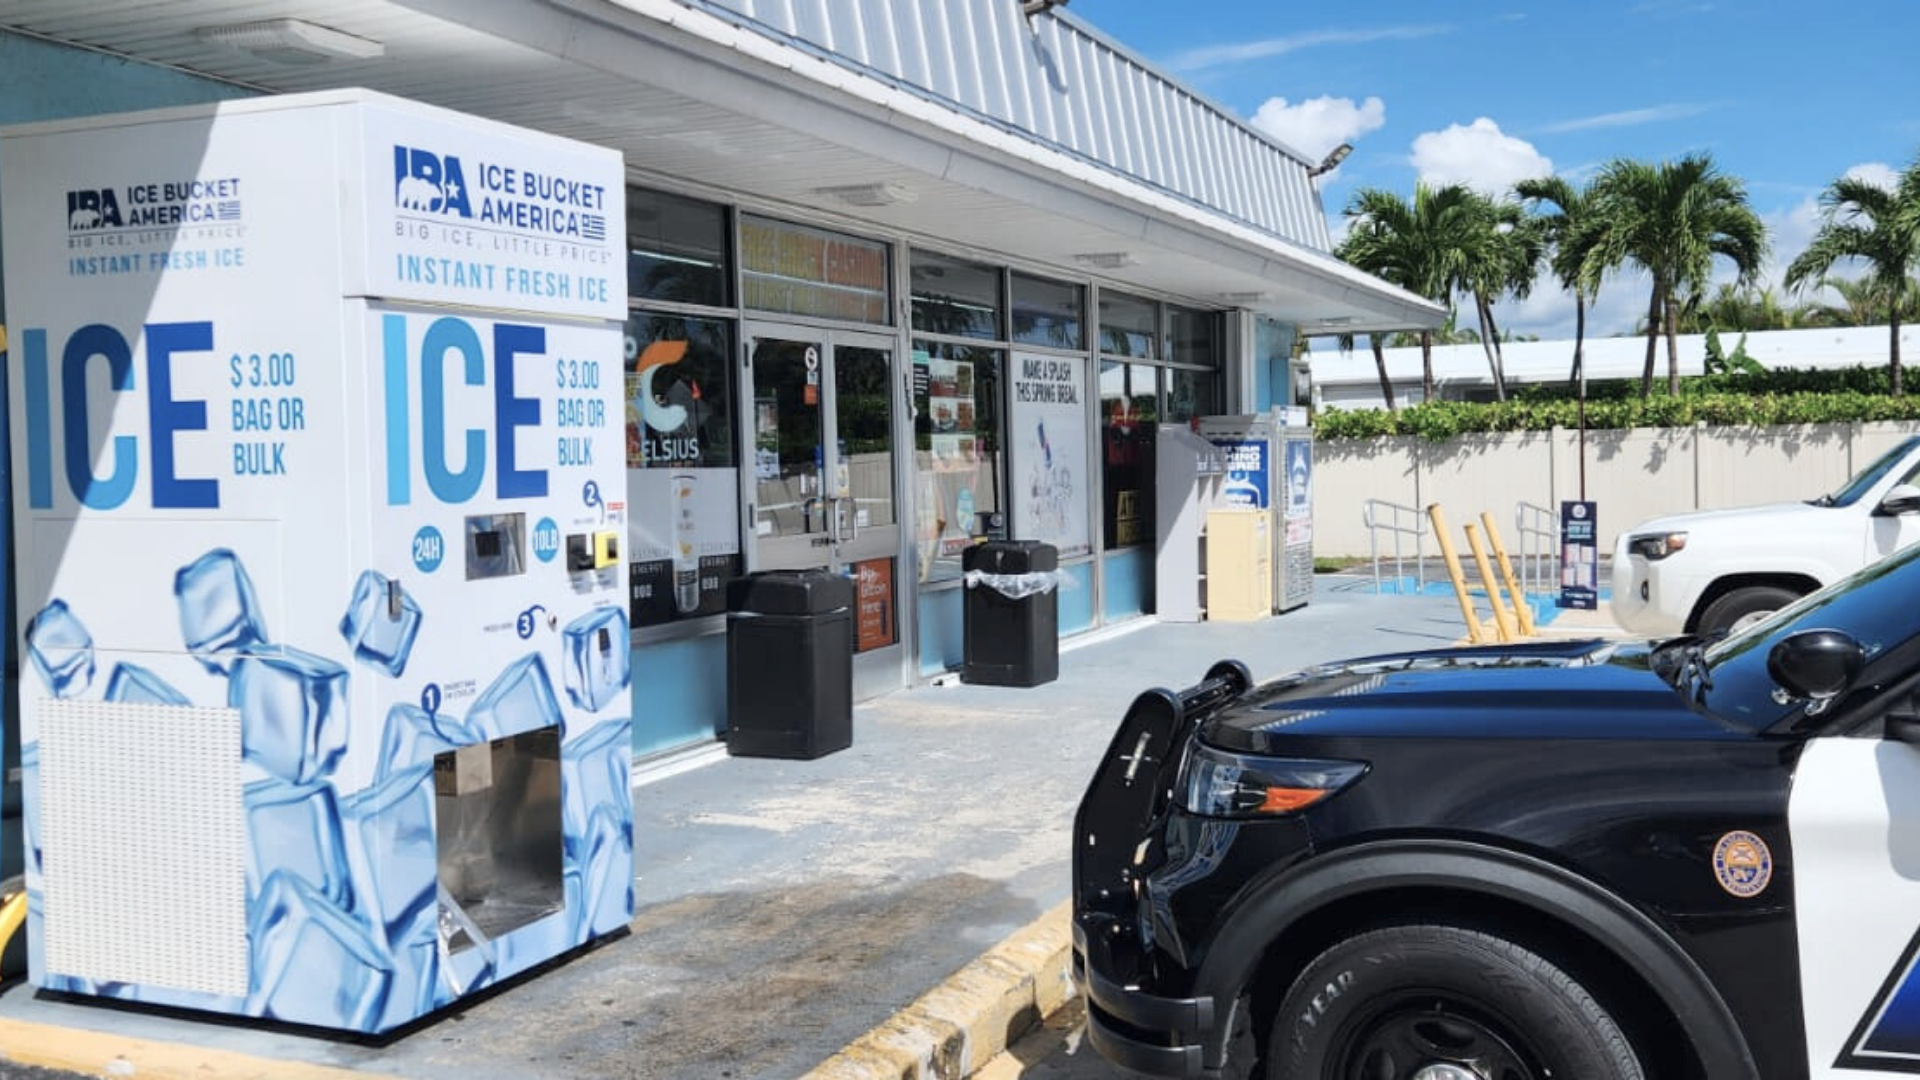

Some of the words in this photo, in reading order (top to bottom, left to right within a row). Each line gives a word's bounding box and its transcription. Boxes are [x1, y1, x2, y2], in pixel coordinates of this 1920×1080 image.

[128, 185, 158, 204] ICE
[163, 178, 241, 201] BUCKET
[394, 145, 472, 218] IBA
[479, 163, 516, 194] ICE
[523, 171, 605, 210] BUCKET
[67, 188, 123, 230] IBA
[129, 203, 215, 226] AMERICA
[480, 197, 579, 236] AMERICA
[68, 236, 93, 249] BIG
[396, 221, 430, 240] BIG
[442, 229, 482, 249] ICE,
[494, 236, 552, 257] LITTLE
[69, 253, 142, 277] INSTANT
[150, 250, 207, 272] FRESH
[216, 248, 244, 266] ICE
[397, 254, 495, 290] INSTANT
[505, 266, 570, 298] FRESH
[579, 276, 608, 302] ICE
[22, 321, 220, 511] ICE
[232, 398, 272, 431] BAG
[278, 397, 305, 430] OR
[382, 313, 549, 505] ICE
[558, 398, 584, 428] BAG
[588, 399, 605, 428] OR
[233, 442, 286, 475] BULK
[558, 436, 593, 467] BULK
[414, 536, 440, 562] 24H
[533, 528, 558, 552] 10LB
[1302, 970, 1354, 1027] YEAR
